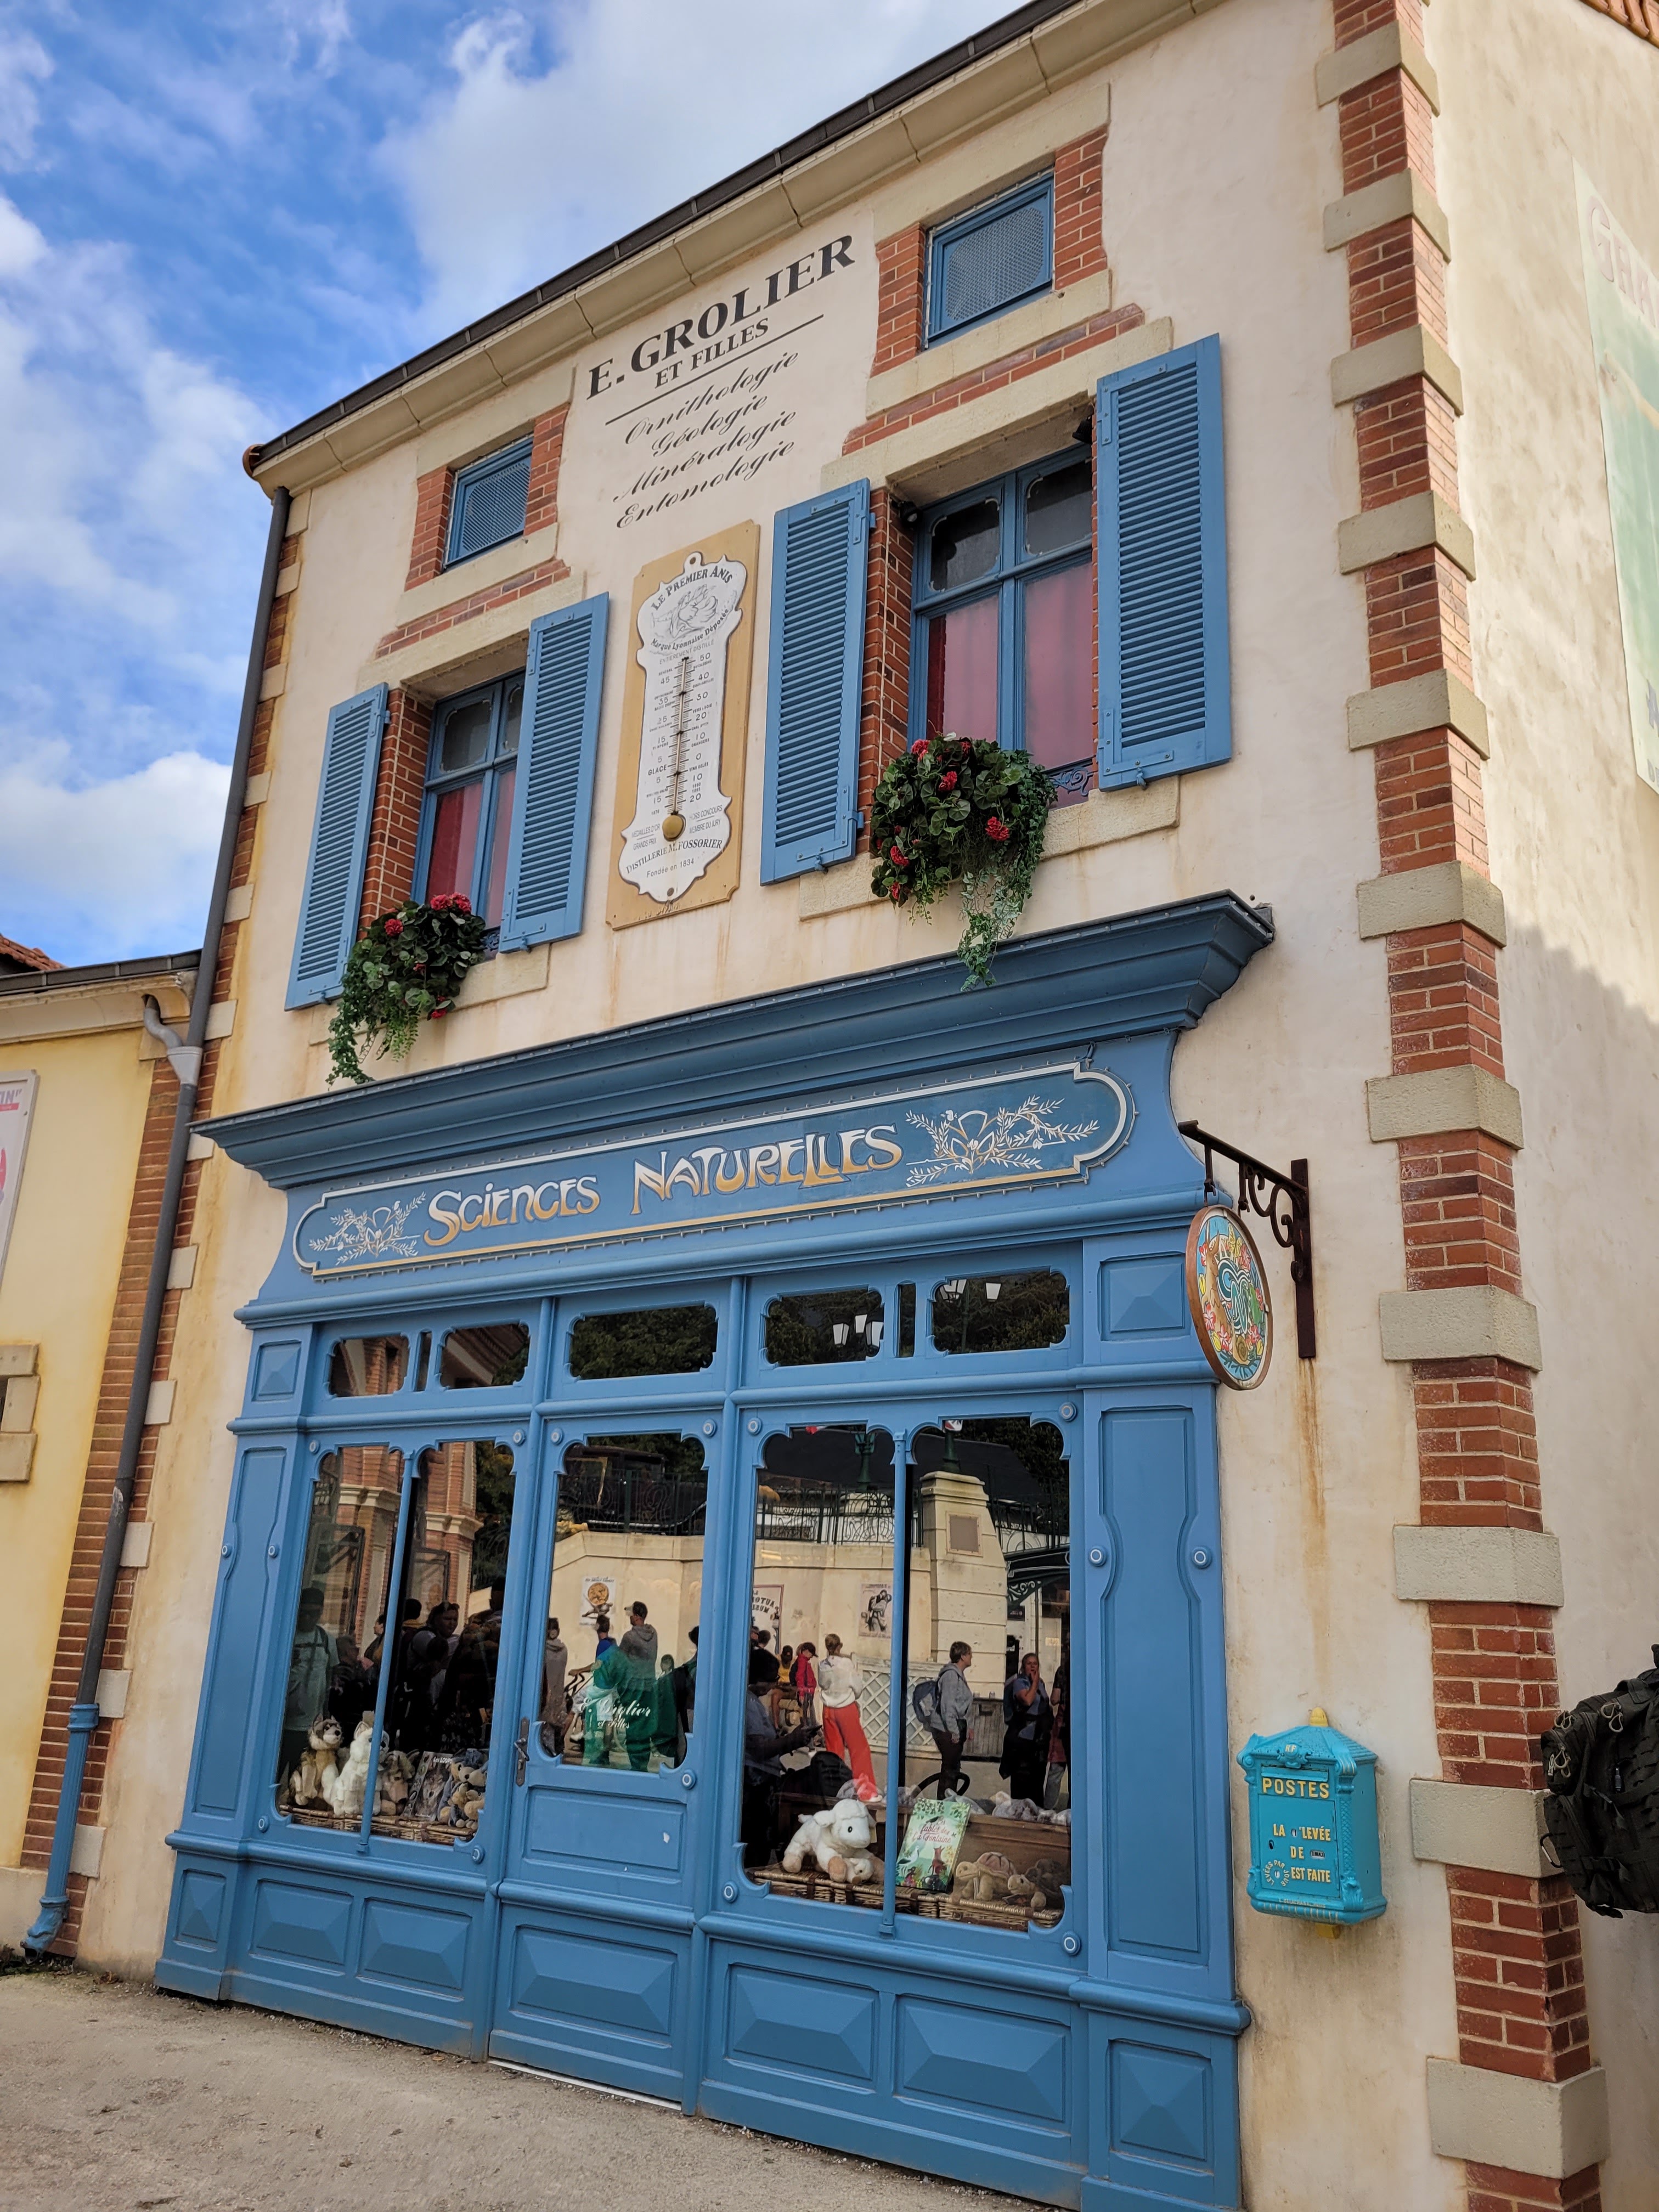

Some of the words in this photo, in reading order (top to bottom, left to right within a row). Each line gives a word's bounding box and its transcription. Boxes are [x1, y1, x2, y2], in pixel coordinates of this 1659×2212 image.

[631, 235, 855, 372] GROLIER
[654, 361, 682, 388] ET
[690, 318, 769, 371] FILLES
[625, 351, 799, 444] Ornithologie
[652, 393, 768, 457] Géologie
[613, 409, 796, 502] Minéralogie
[616, 439, 794, 528] Entomologie
[651, 595, 665, 611] LE
[665, 569, 708, 596] PREMIER
[710, 566, 732, 583] ANIS
[651, 639, 671, 651] Marque
[673, 633, 703, 650] Lyonnaise
[700, 652, 710, 661] 50
[698, 672, 709, 681] 40
[658, 697, 668, 705] 35
[697, 692, 708, 701] 30
[657, 715, 667, 725] 25
[696, 712, 707, 721] 20
[658, 736, 665, 744] 15
[648, 764, 667, 776] GLACE
[693, 773, 702, 781] 10
[654, 795, 662, 804] 15
[690, 793, 701, 803] 20
[689, 824, 705, 833] MEMBRE
[711, 819, 720, 827] JURY
[633, 840, 648, 850] GRANDS
[627, 847, 667, 874] DISTILLERIE
[647, 867, 668, 878] Fondée
[680, 858, 694, 868] 1834
[632, 1125, 904, 1215] NATURELLES
[1262, 1777, 1330, 1799] POSTES
[923, 1832, 951, 1843] Fontaine
[1273, 1823, 1286, 1837] LA
[1302, 1826, 1331, 1841] LEVÉE
[1290, 1846, 1304, 1859] DE
[1273, 1859, 1285, 1869] PAR
[1280, 1869, 1290, 1887] JOUR
[1291, 1866, 1305, 1880] EST
[1307, 1869, 1331, 1883] FAITE
